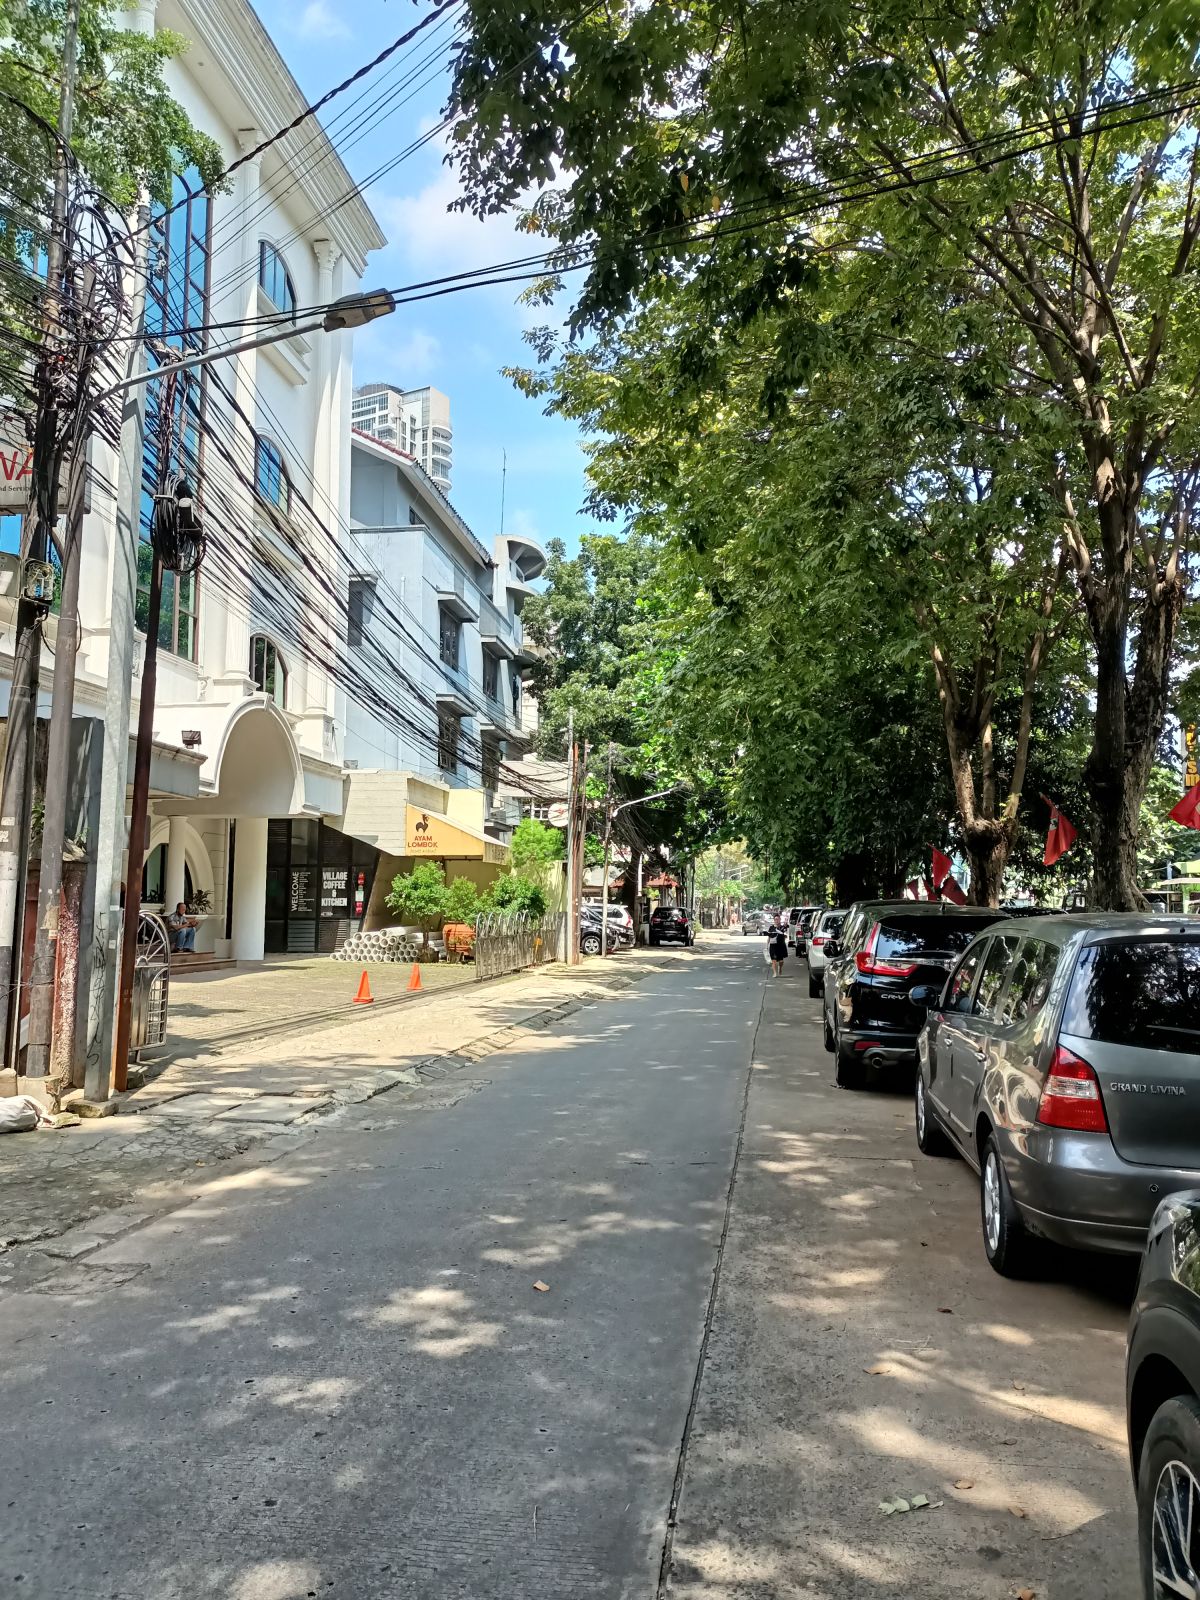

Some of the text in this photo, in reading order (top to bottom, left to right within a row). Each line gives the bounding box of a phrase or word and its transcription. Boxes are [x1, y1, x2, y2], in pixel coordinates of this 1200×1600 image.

[322, 871, 348, 880] VILLAGE
[323, 880, 346, 889] COFFEE
[291, 871, 299, 912] WELCOME
[321, 897, 348, 906] KITCHEN
[1110, 1082, 1186, 1095] GRAND LIVINA
